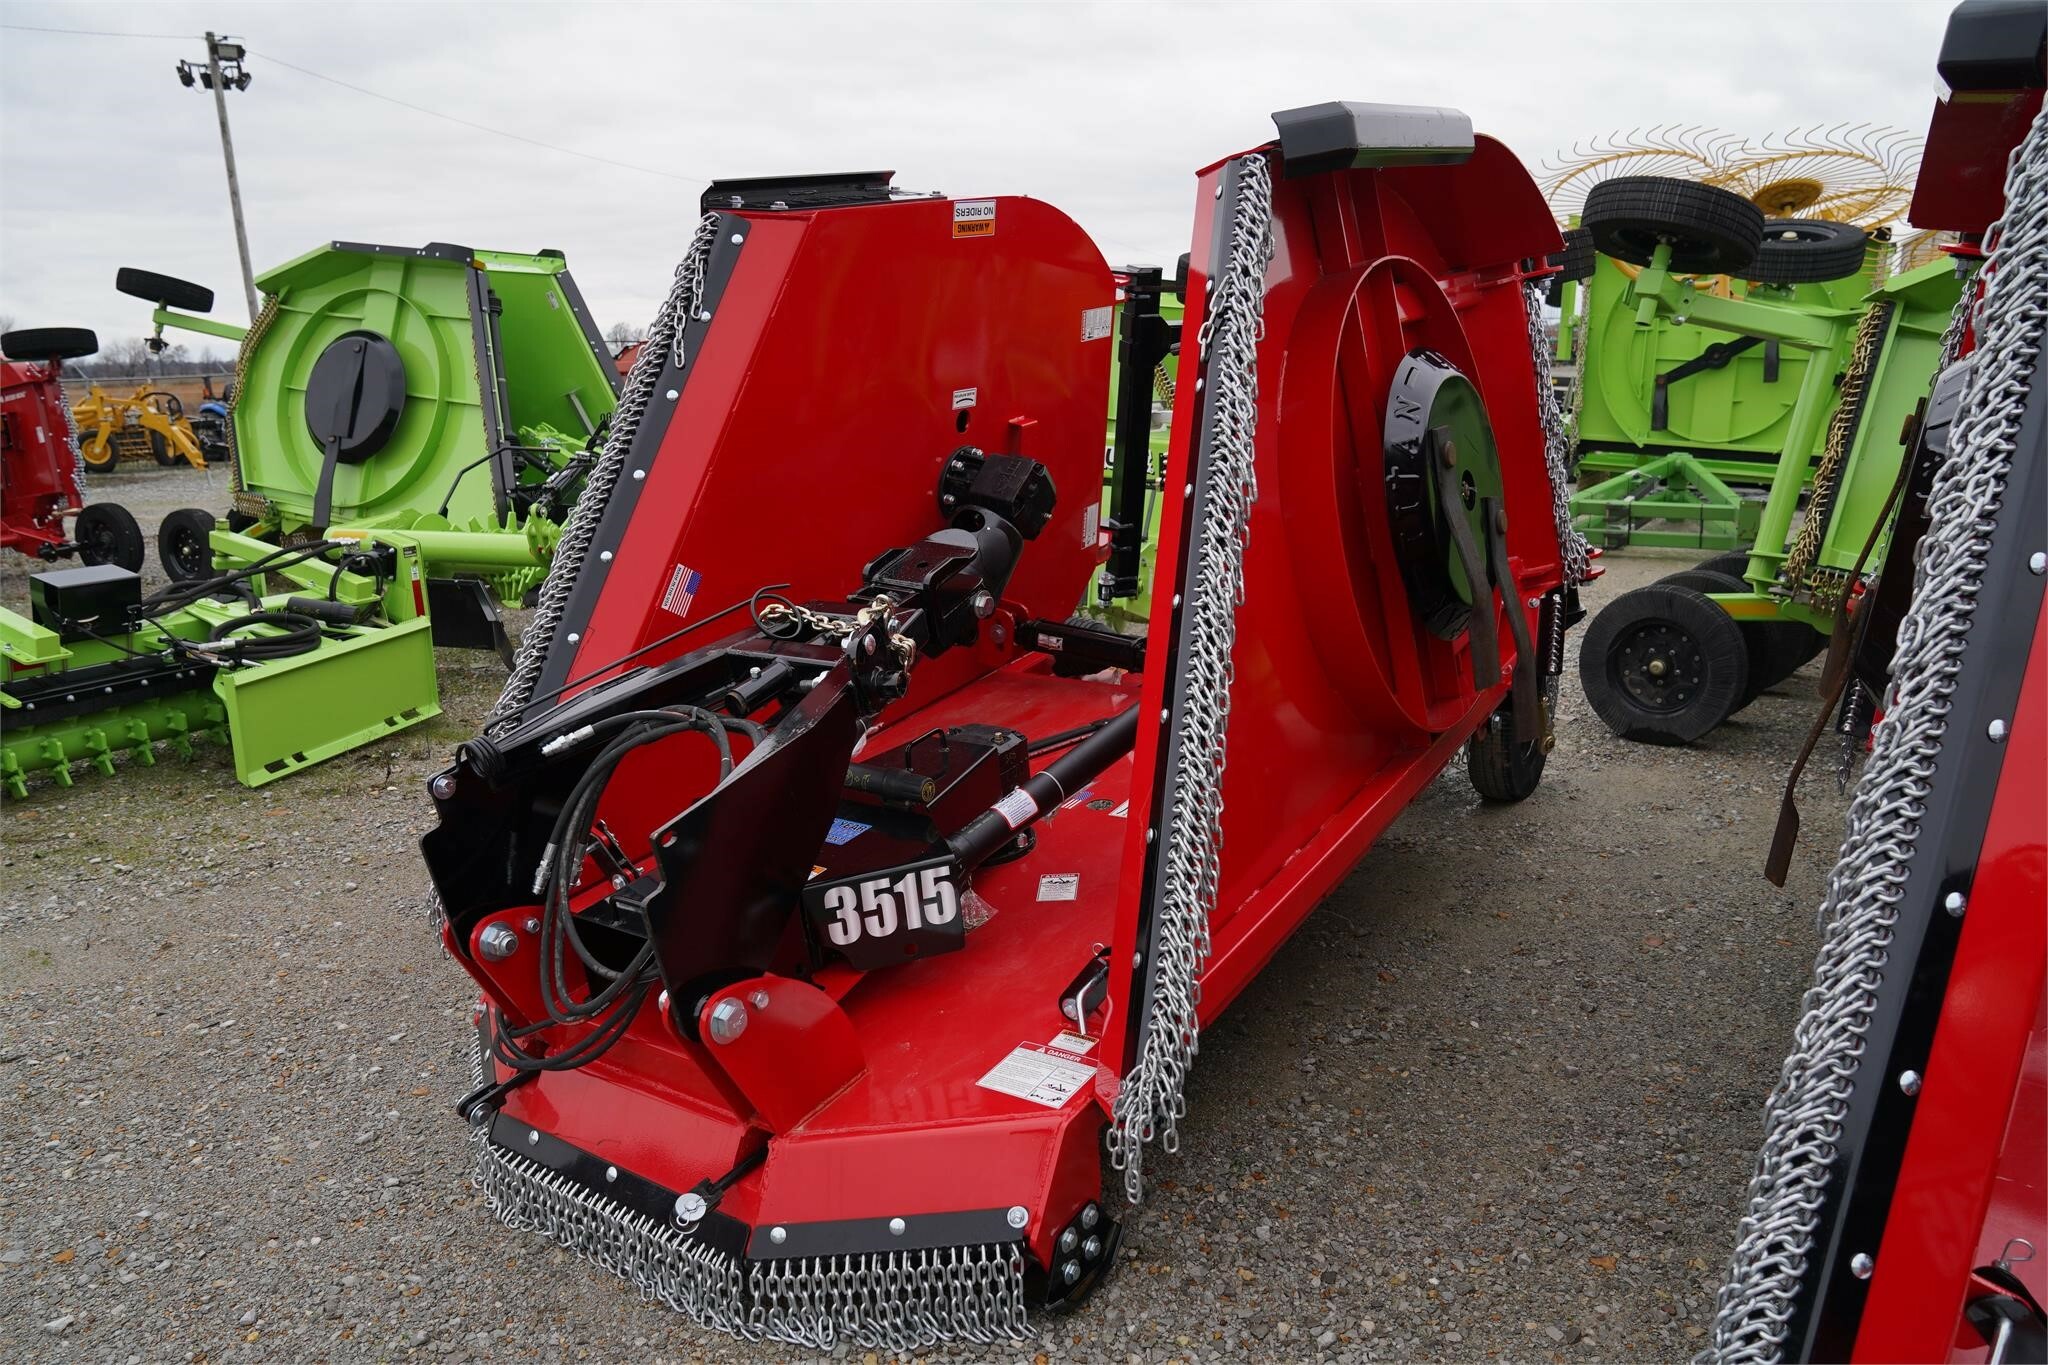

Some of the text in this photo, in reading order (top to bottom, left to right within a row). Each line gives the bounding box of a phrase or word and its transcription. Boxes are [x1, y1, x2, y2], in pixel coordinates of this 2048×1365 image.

[955, 206, 994, 217] NO RIDERS
[957, 222, 986, 234] WARNING
[824, 865, 957, 946] 3515
[1046, 1049, 1082, 1062] DANGER
